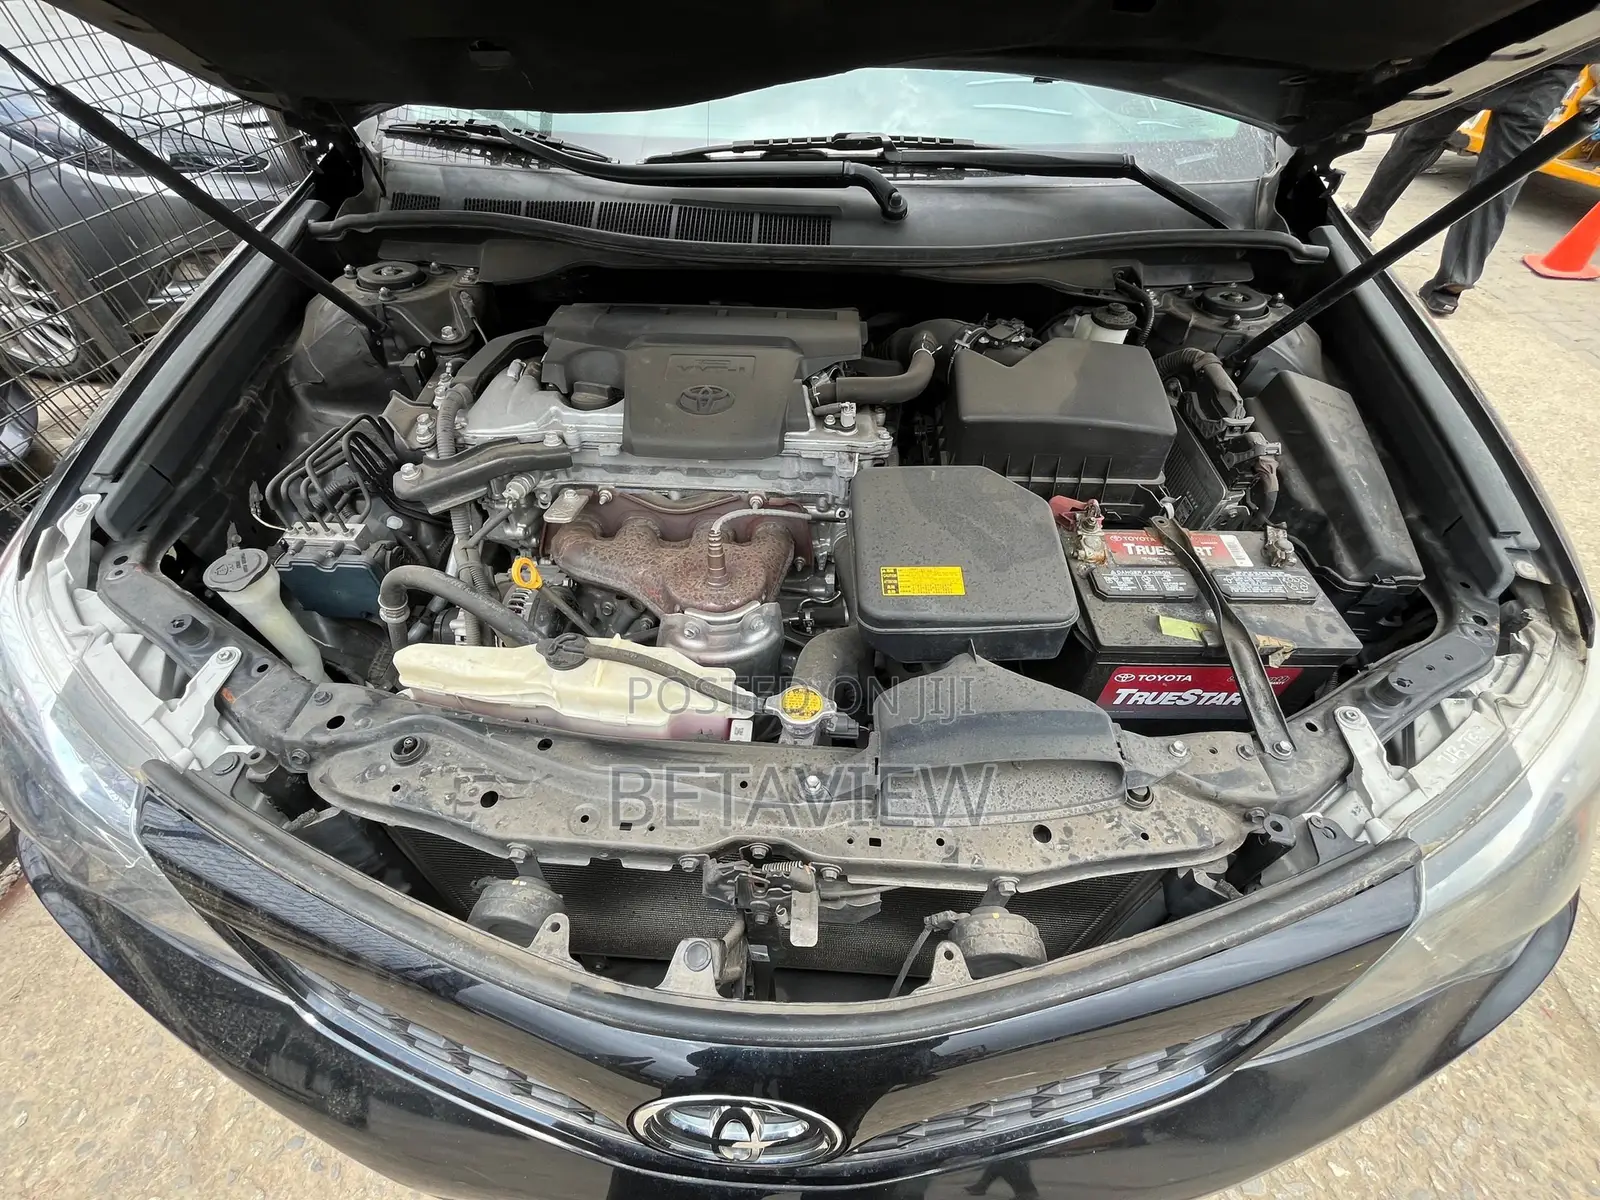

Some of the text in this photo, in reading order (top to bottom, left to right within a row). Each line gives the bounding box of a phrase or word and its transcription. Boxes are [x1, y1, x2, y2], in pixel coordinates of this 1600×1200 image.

[1122, 543, 1213, 557] TRUESRT
[1138, 674, 1192, 682] TOYOTA
[1112, 688, 1243, 706] TRUESTAR
